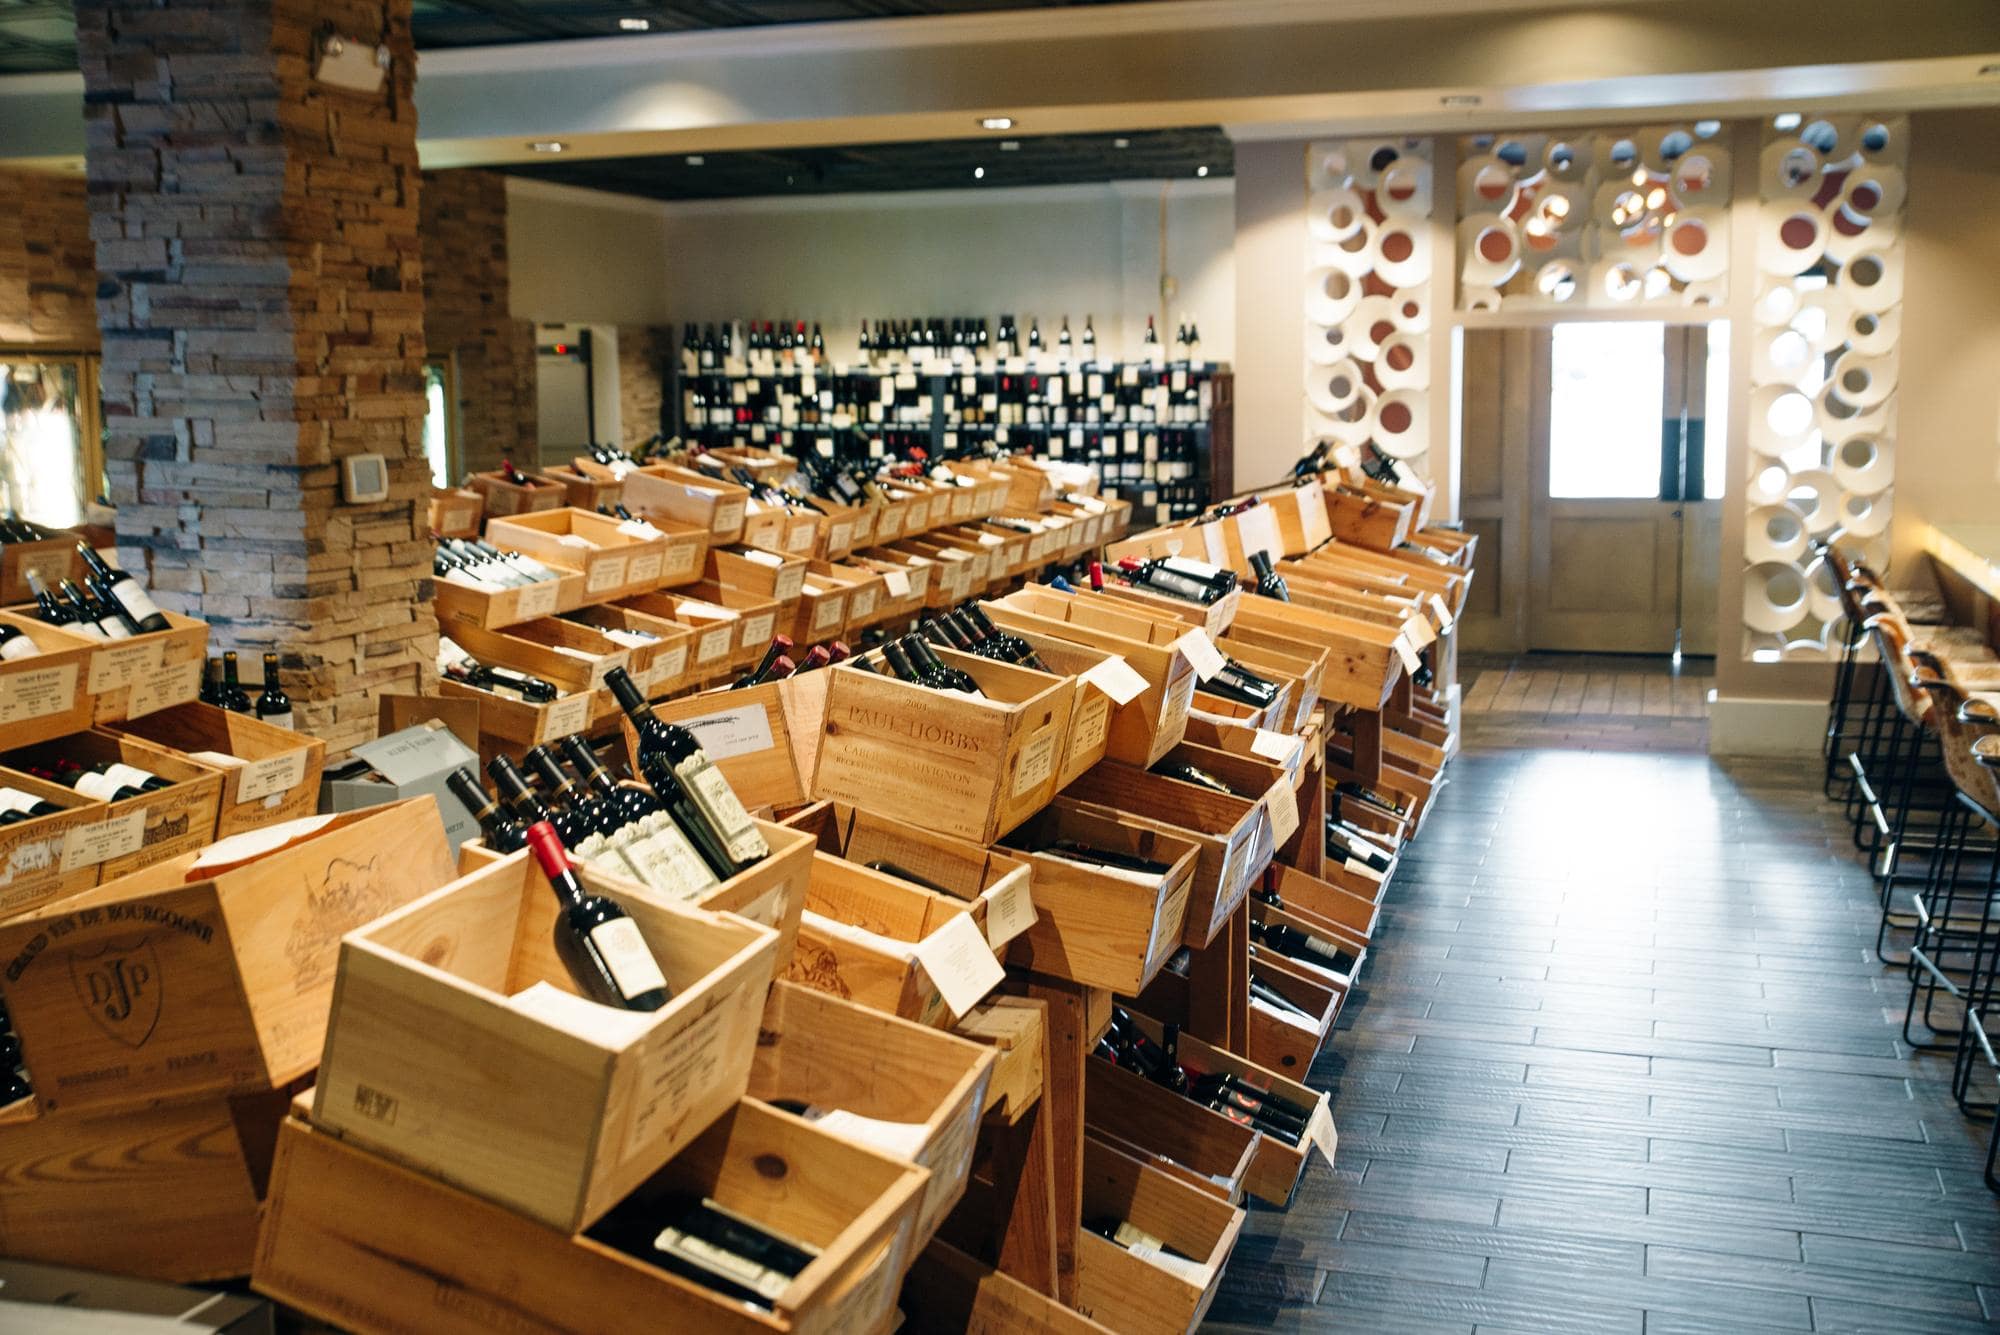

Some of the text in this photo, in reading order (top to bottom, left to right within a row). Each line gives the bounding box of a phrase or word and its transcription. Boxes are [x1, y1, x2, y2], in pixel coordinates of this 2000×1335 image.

[849, 705, 981, 753] PAUL HOBBS
[80, 910, 102, 928] DE
[107, 903, 214, 944] BOURGOGNE
